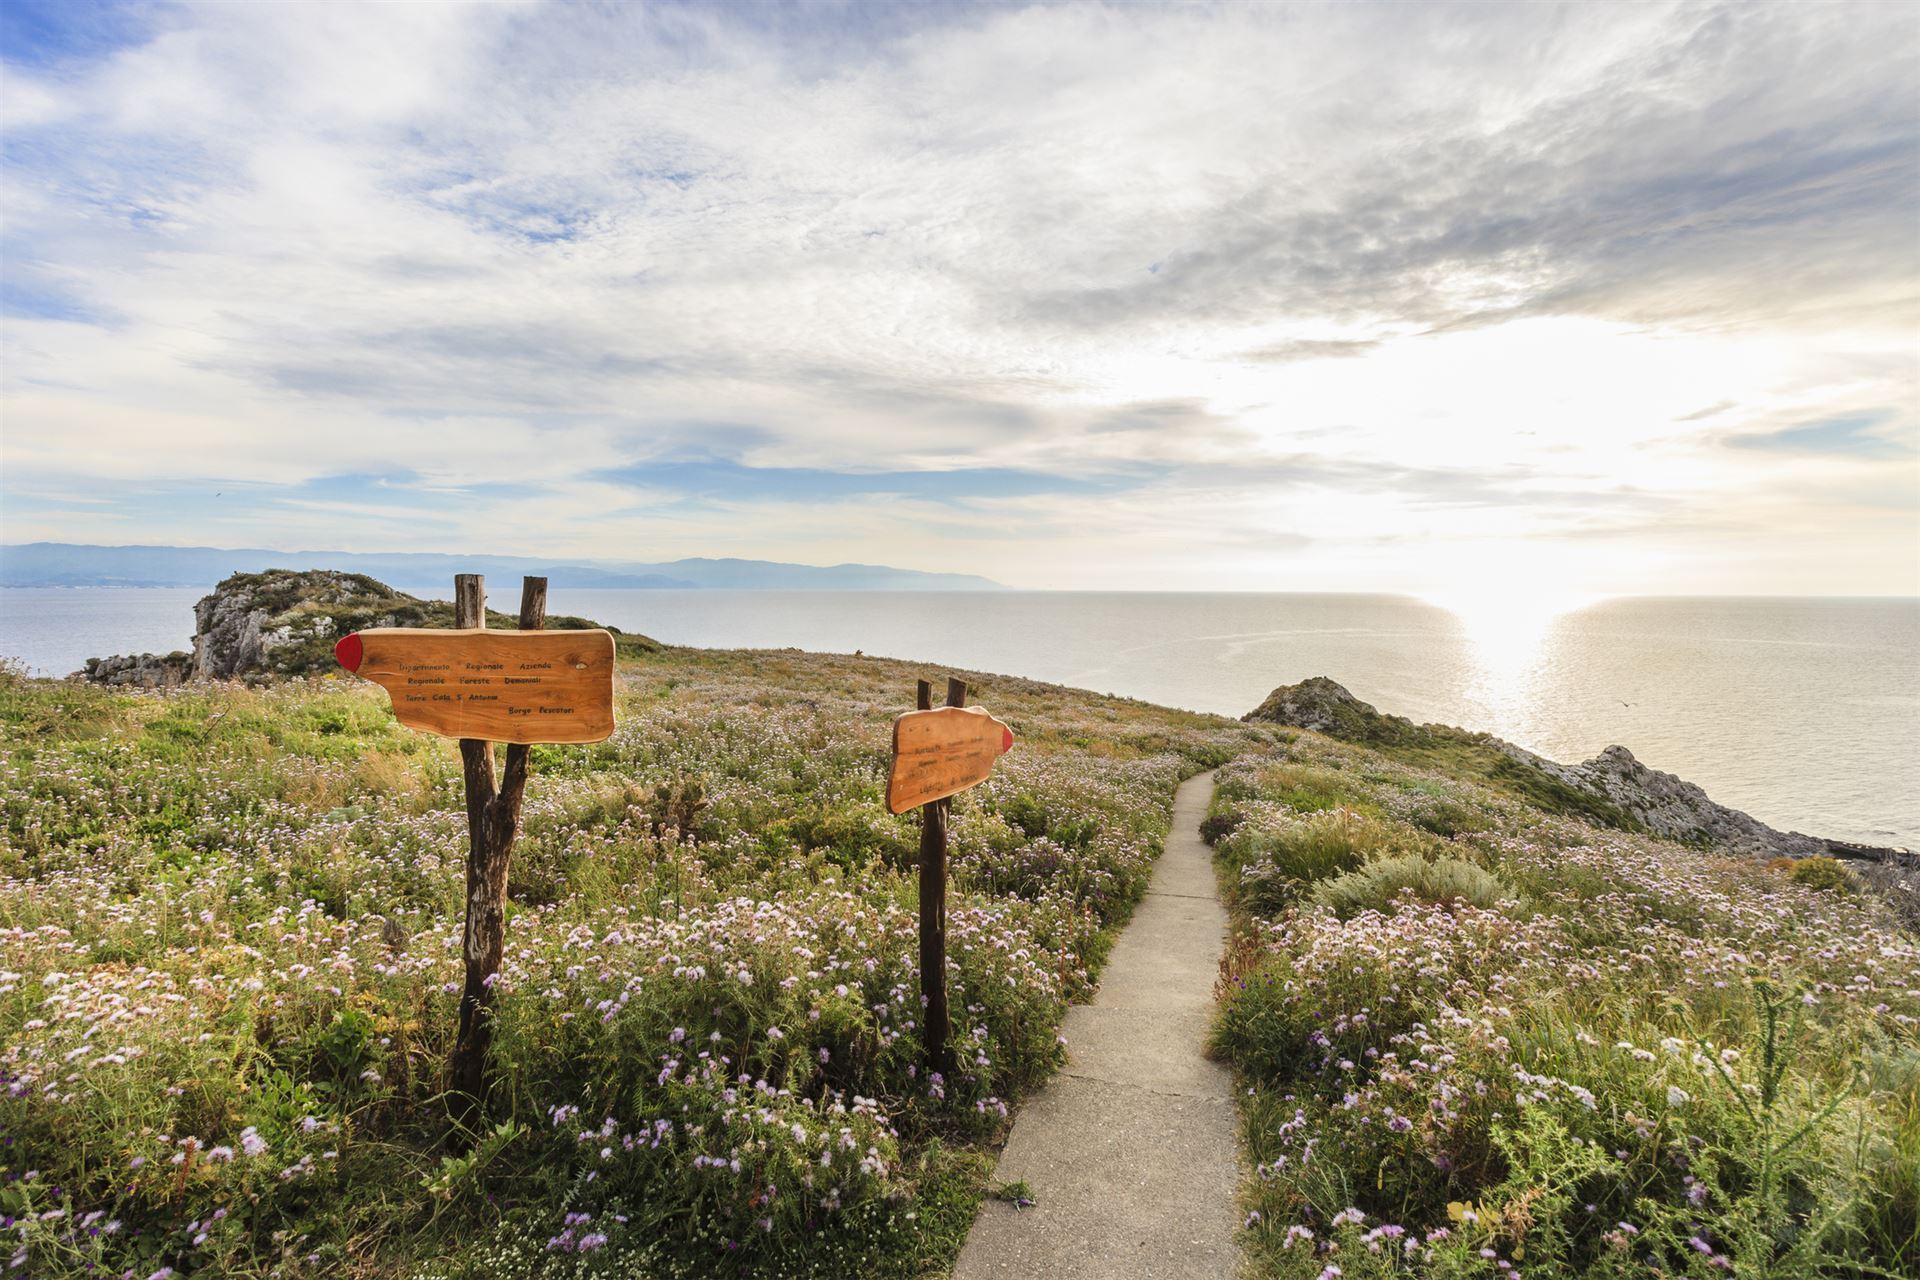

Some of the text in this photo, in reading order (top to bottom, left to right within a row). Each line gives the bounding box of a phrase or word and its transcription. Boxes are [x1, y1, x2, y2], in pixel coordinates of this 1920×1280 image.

[408, 677, 445, 686] Regionale
[508, 706, 574, 716] Borgo Pescatori
